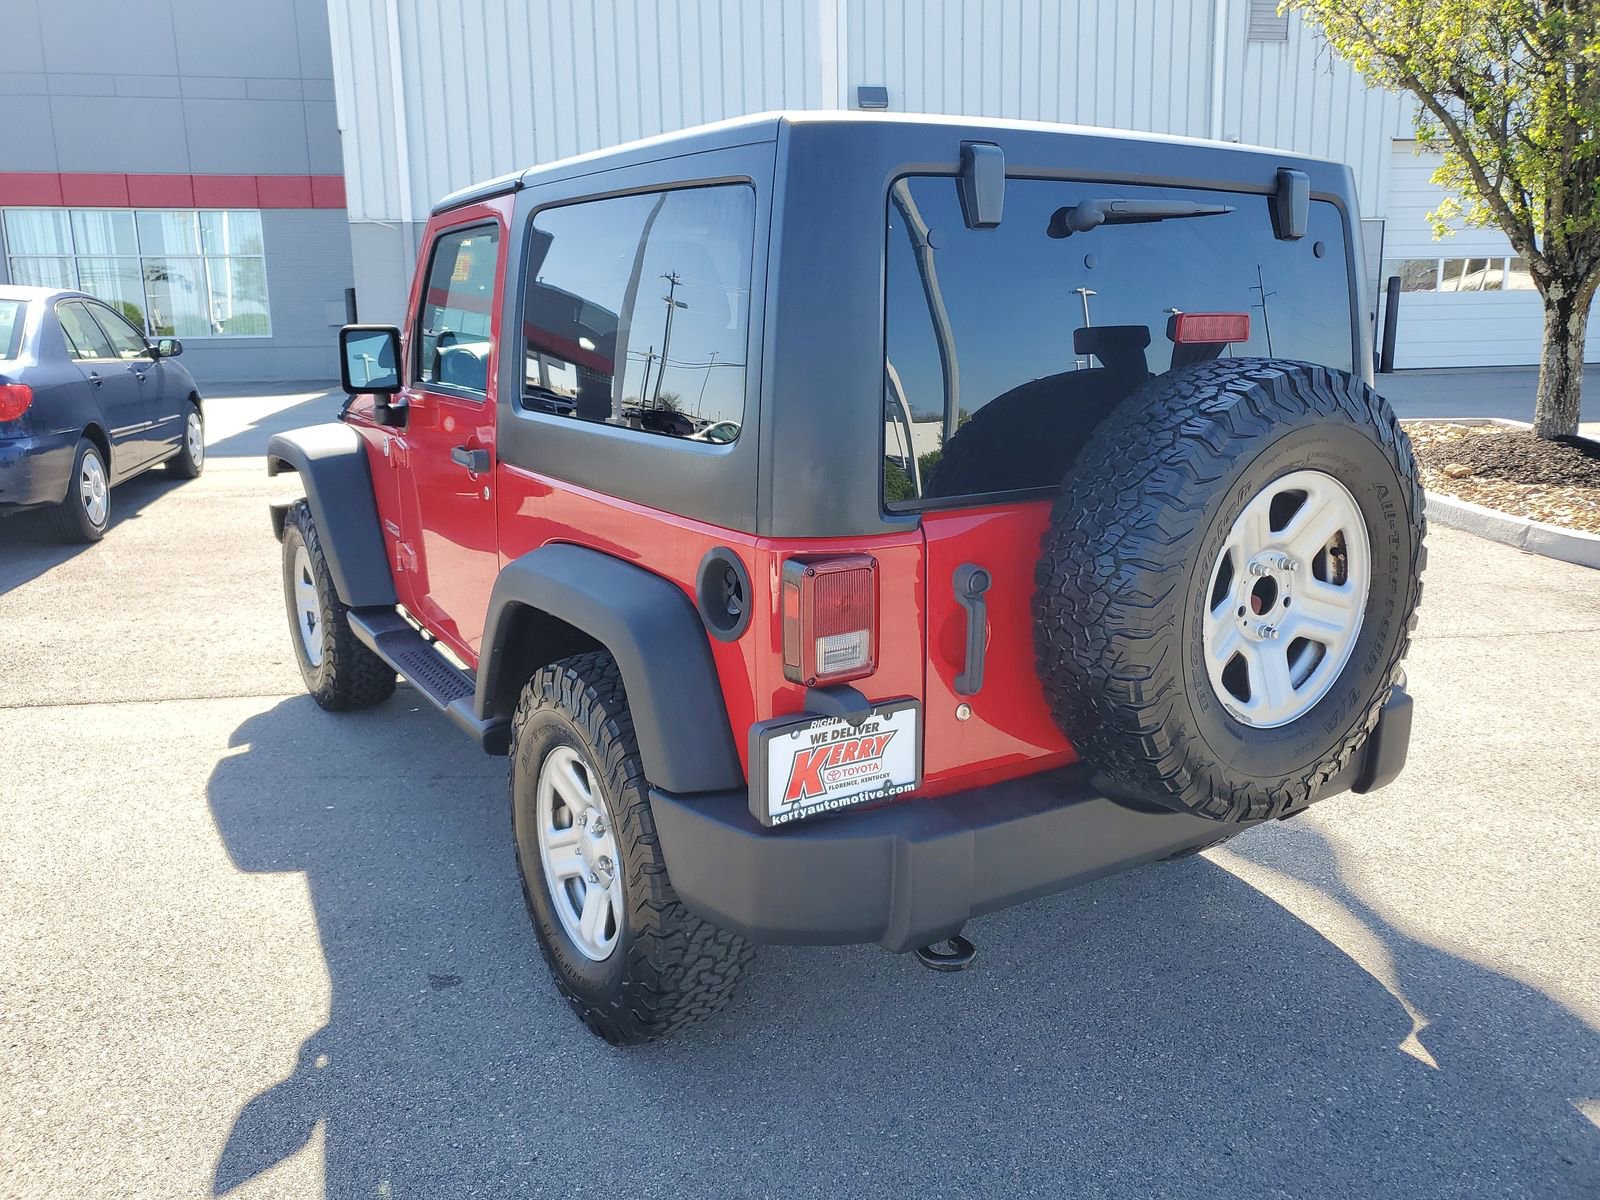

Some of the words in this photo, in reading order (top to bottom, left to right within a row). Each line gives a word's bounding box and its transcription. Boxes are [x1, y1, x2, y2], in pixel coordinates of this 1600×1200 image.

[810, 732, 828, 745] WE
[831, 722, 880, 741] DELIVER
[782, 730, 898, 805] KERRY
[842, 762, 880, 777] TOYOTA
[828, 779, 860, 791] FLORENCE,
[860, 772, 891, 785] KENTUCKY
[771, 783, 915, 826] kerryautomotive.com
